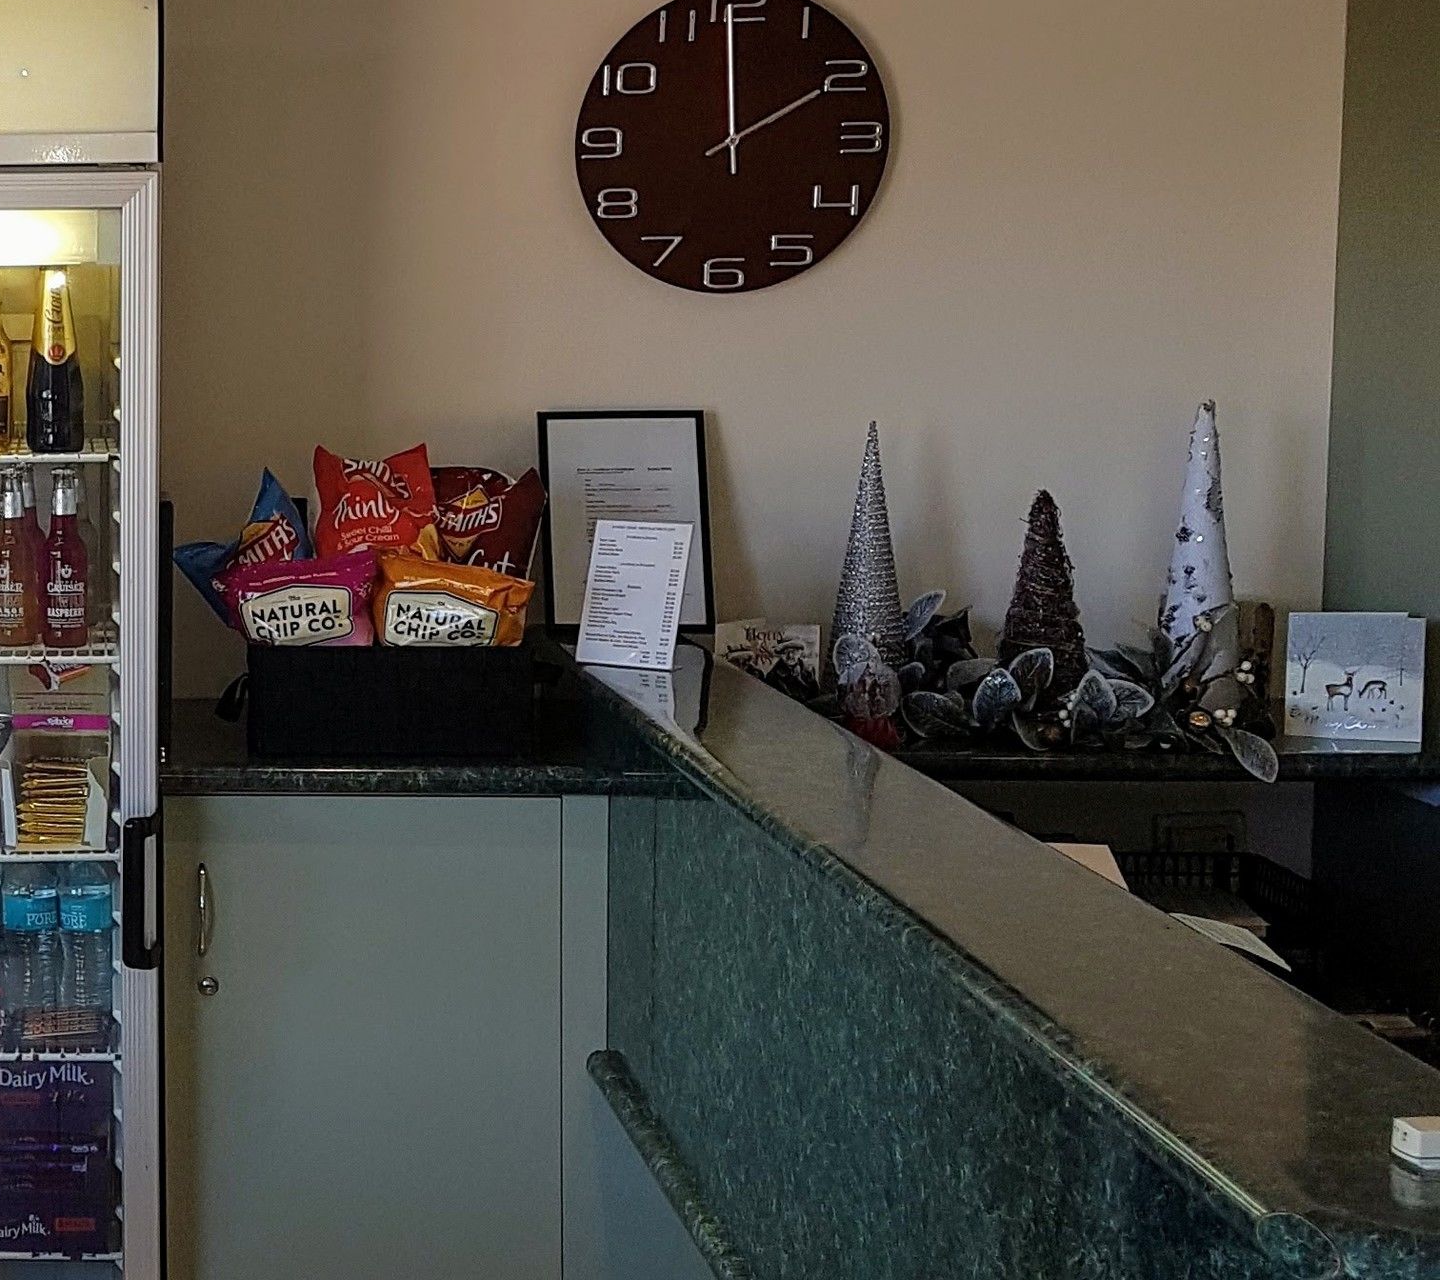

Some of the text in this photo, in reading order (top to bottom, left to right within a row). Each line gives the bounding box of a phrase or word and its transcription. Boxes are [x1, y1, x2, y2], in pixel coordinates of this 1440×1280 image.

[659, 10, 696, 42] 11
[801, 6, 810, 39] 1
[603, 62, 657, 96] 10
[824, 60, 868, 92] 2
[581, 127, 623, 159] 9
[840, 121, 882, 154] 3
[597, 188, 638, 219] 8
[813, 184, 859, 216] 4
[641, 236, 683, 266] 7
[769, 234, 814, 266] 5
[703, 258, 745, 289] 6
[333, 491, 400, 530] Thinly
[365, 533, 400, 542] Cream
[251, 599, 342, 624] NATURAL
[397, 603, 486, 631] NATURAL
[256, 620, 300, 640] CHIP
[393, 620, 440, 640] CHIP
[50, 1063, 95, 1085] Milk
[21, 1221, 51, 1236] Milk
